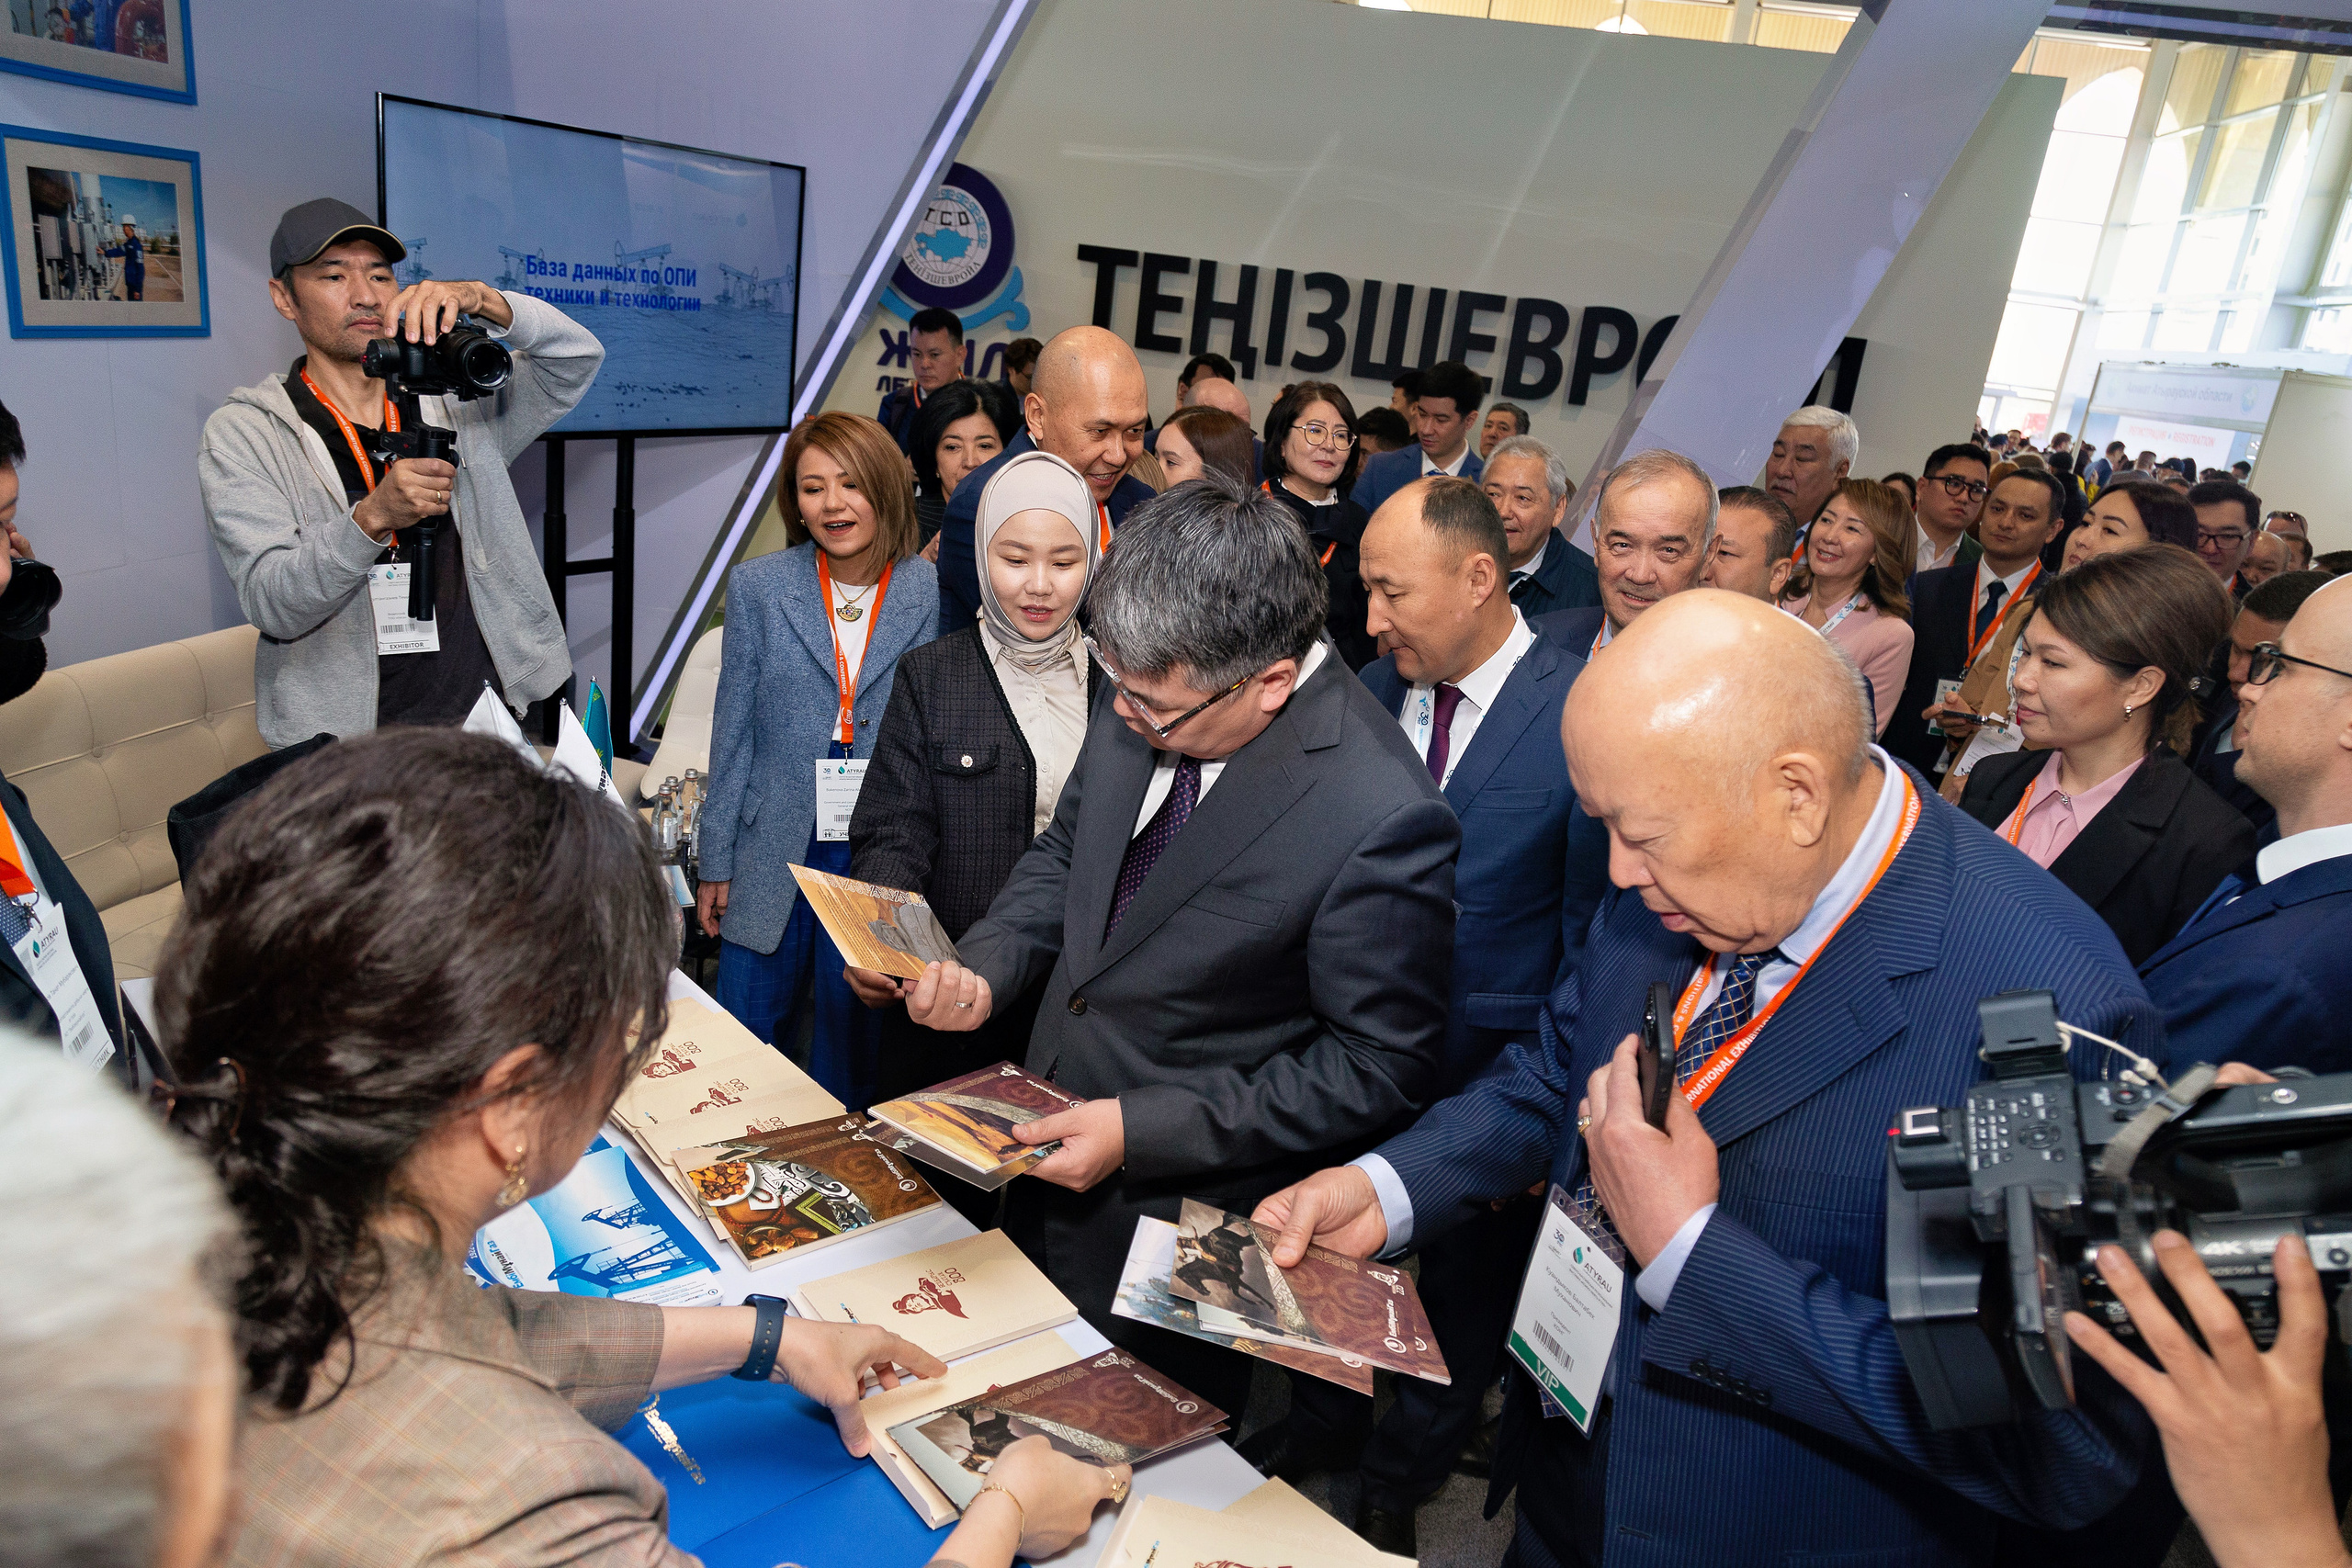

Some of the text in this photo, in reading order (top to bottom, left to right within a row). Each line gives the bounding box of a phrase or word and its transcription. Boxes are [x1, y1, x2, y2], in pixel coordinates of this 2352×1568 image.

[526, 254, 697, 287] База данных по ОПИ
[525, 287, 702, 311] техники и технологии
[2173, 432, 2216, 447] REGISTRATION
[1420, 711, 1429, 726] 30
[40, 927, 59, 948] ATYRAU
[683, 1041, 702, 1055] 800
[729, 1077, 750, 1091] 800
[1554, 1228, 1566, 1243] 30
[944, 1267, 966, 1284] 800
[1584, 1262, 1612, 1293] ATYRAU
[1536, 1358, 1560, 1390] VIP
